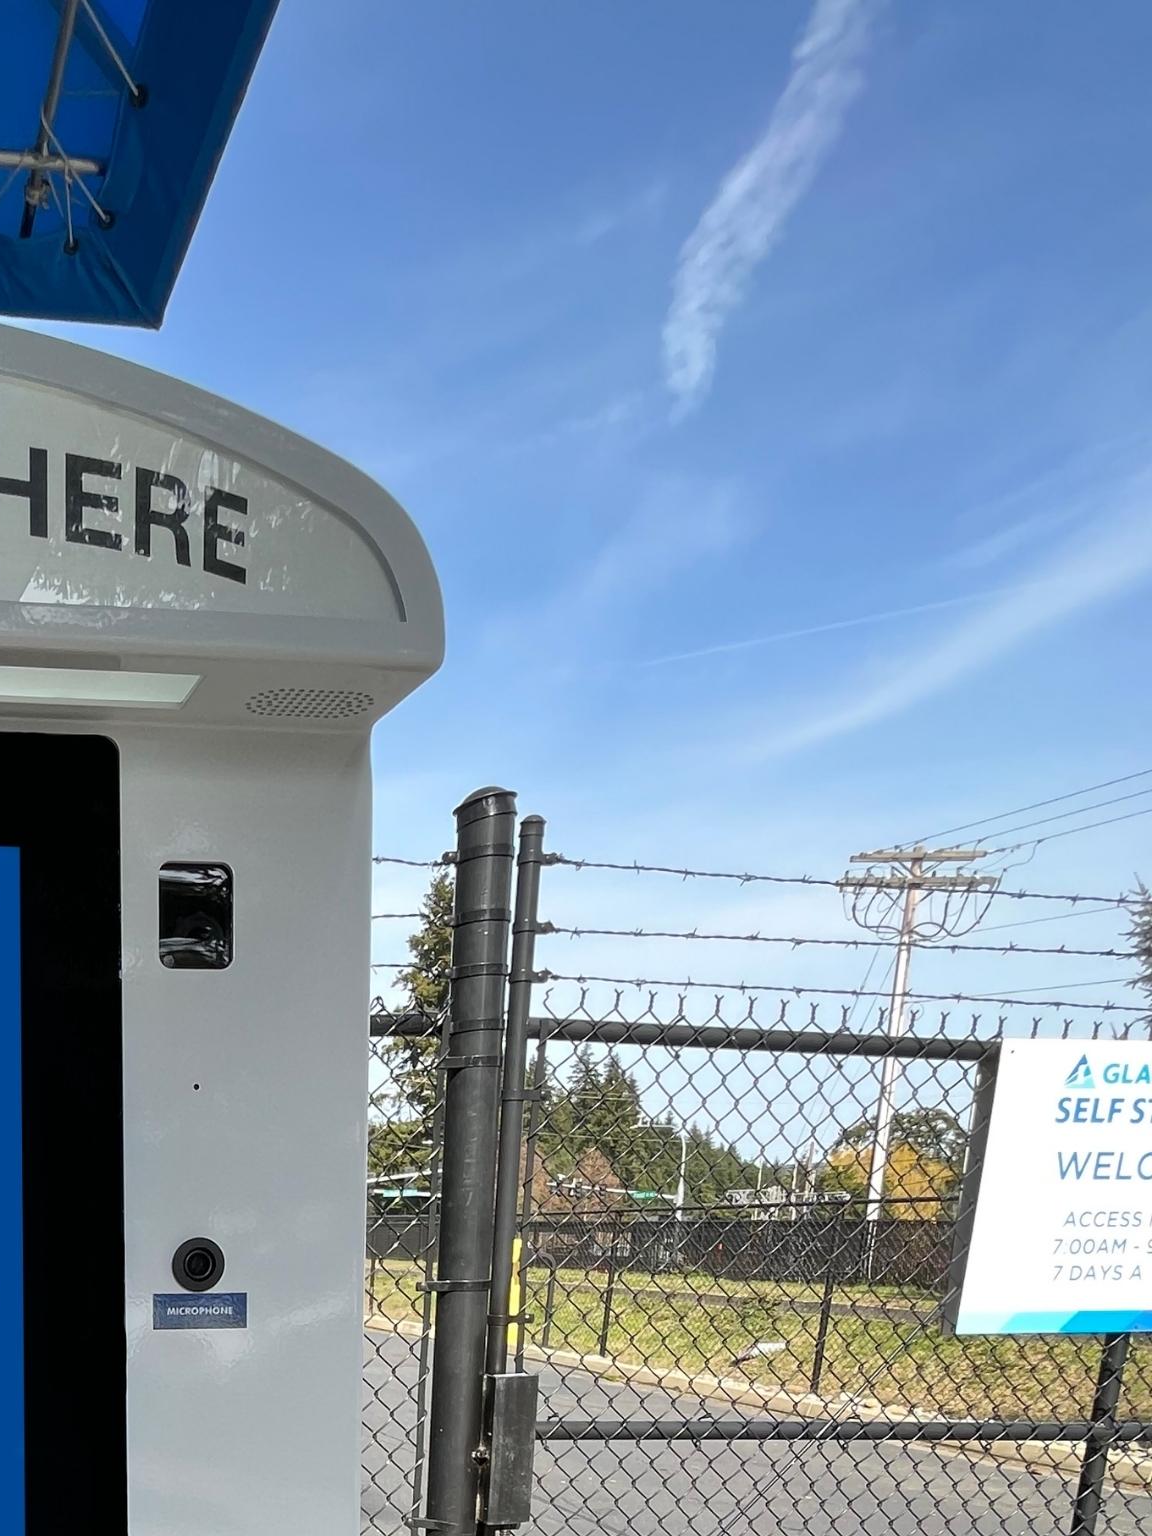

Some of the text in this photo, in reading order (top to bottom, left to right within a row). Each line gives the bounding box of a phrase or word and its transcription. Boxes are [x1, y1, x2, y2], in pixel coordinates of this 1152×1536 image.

[1055, 1097, 1125, 1123] SELF
[1062, 1210, 1143, 1228] ACCESS
[1052, 1238, 1128, 1255] 7:00AM
[1052, 1264, 1143, 1281] 7 DAYS A
[166, 1305, 234, 1316] MICROPHONE
